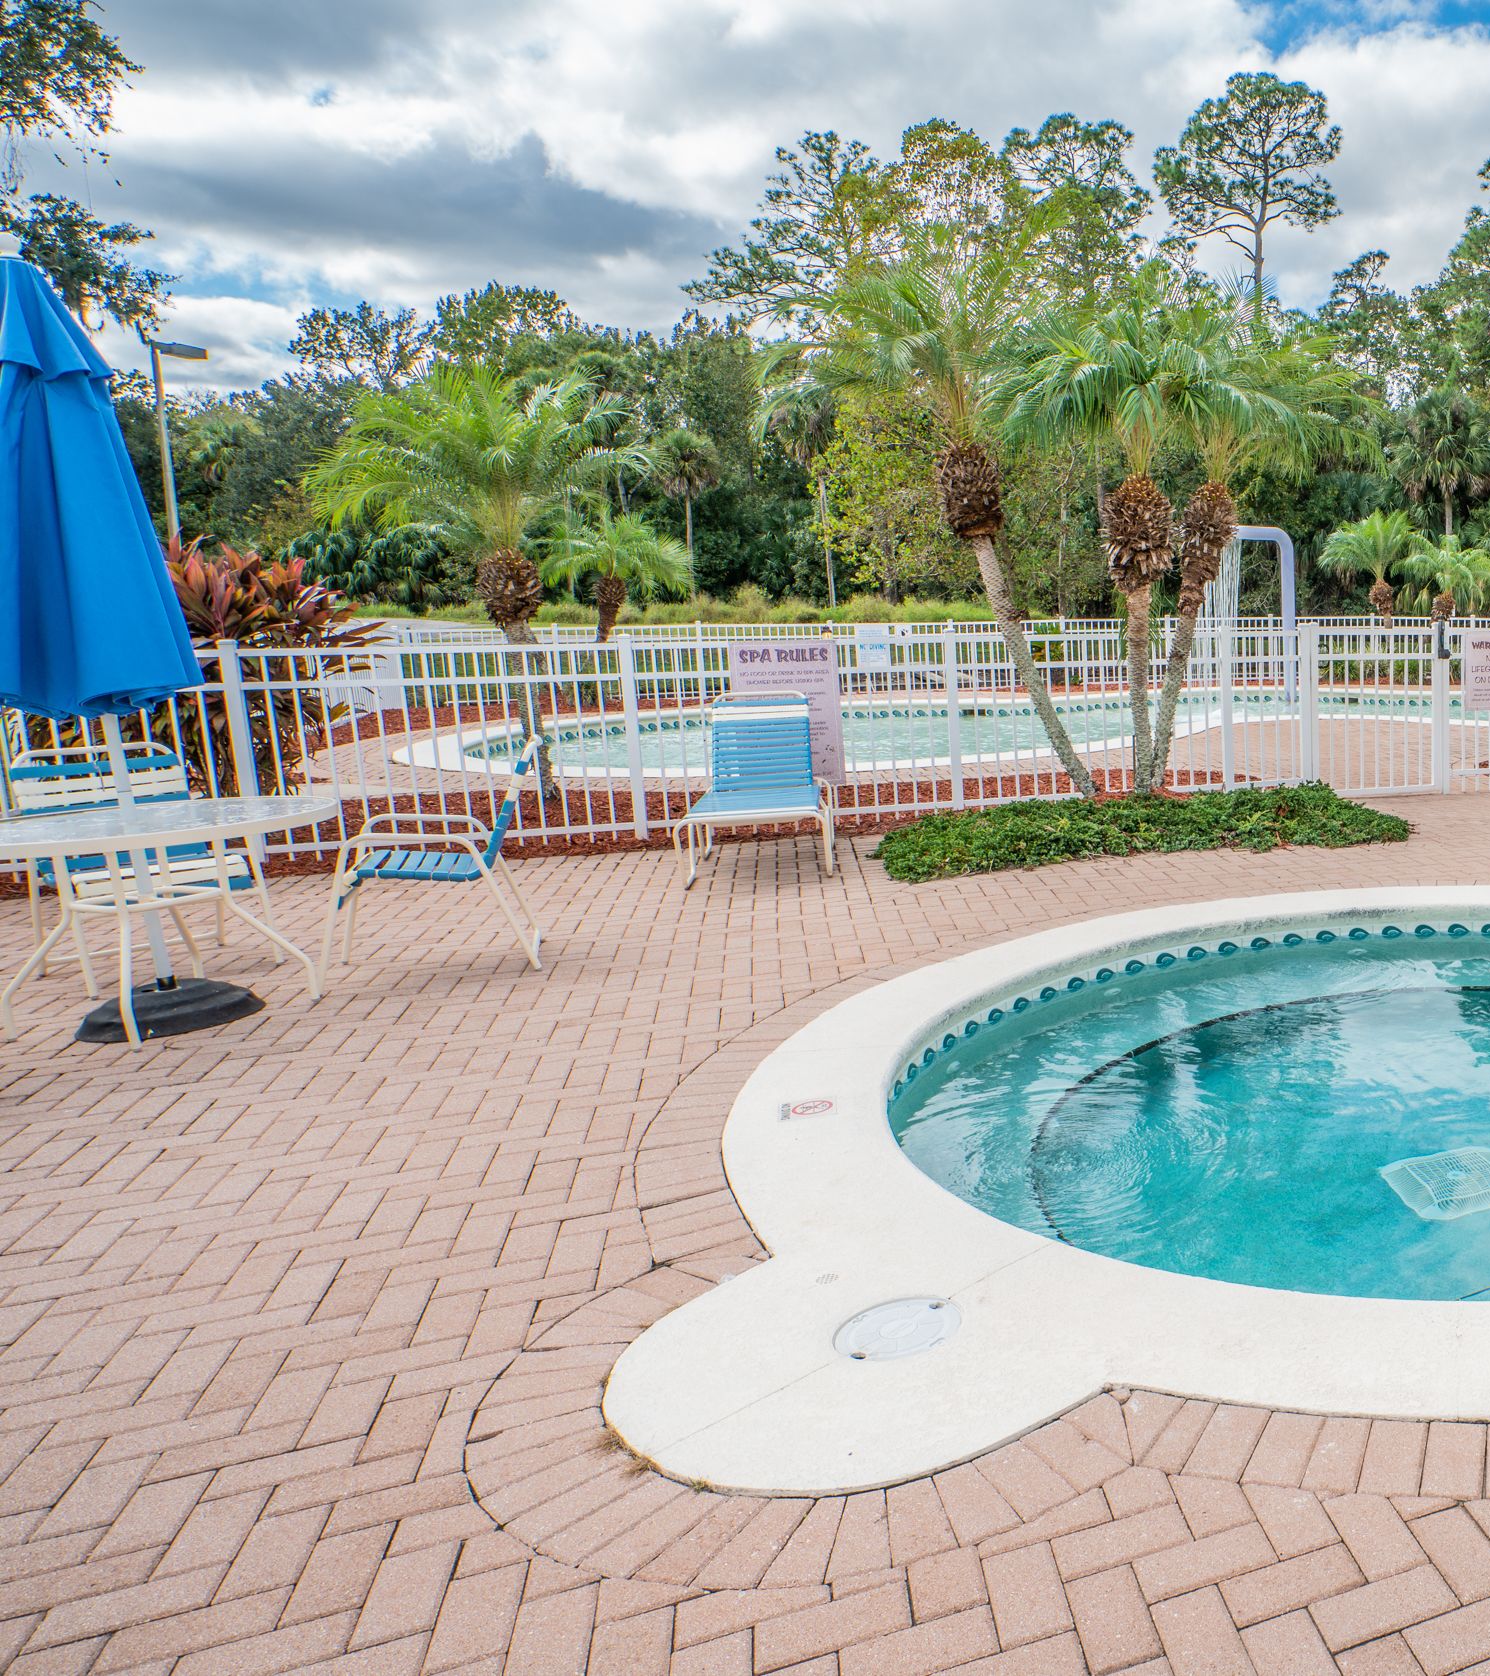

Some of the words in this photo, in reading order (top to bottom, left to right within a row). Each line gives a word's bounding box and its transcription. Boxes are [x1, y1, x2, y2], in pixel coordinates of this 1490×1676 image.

[739, 649, 772, 664] SPA
[775, 647, 828, 663] RULES
[1475, 676, 1486, 684] ON
